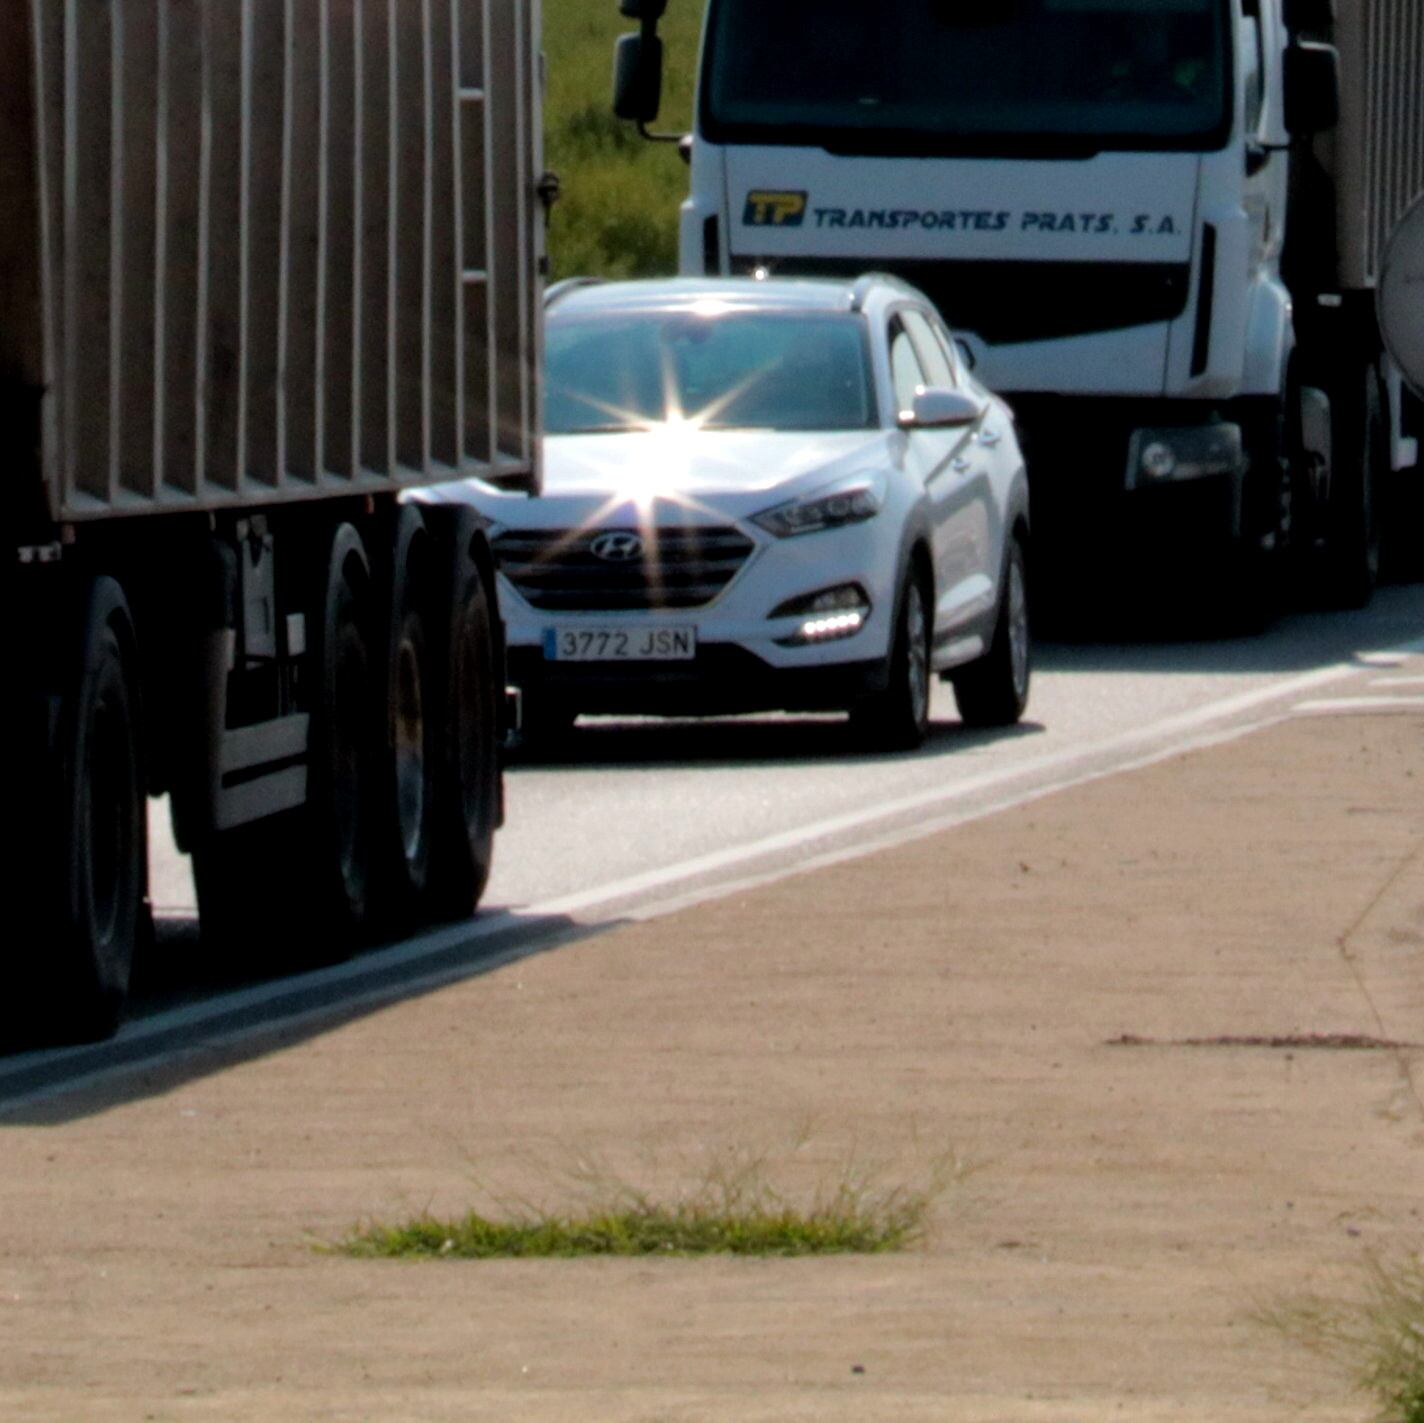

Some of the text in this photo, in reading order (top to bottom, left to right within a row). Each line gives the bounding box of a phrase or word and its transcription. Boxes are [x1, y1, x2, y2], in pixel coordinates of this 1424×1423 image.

[749, 194, 803, 224] TP
[813, 208, 1010, 231] TRANSPORTES
[1129, 213, 1182, 235] S.A.
[563, 630, 689, 656] 3772 JSN
